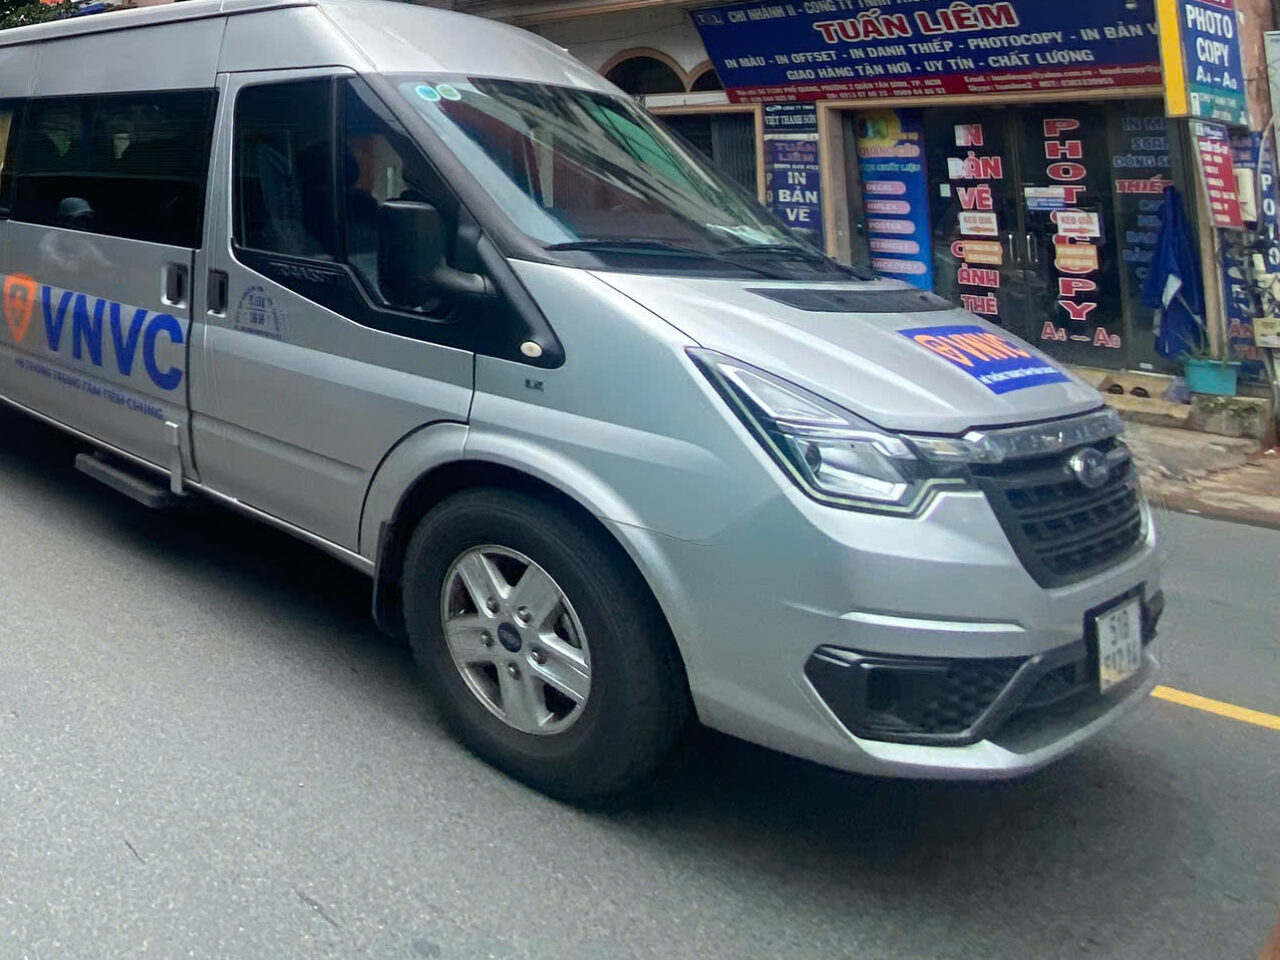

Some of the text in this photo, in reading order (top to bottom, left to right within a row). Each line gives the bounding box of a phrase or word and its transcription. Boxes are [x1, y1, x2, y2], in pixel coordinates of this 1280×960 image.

[728, 8, 747, 23] CHI
[749, 4, 785, 21] NHÁNH
[813, 1, 1020, 44] TUẤN LIÊM
[1185, 4, 1233, 39] PHOTO
[725, 21, 1158, 69] IN MÀU IN OFFSET IN DANH THIẾP PHOTOCOPY IN BẢN V
[1196, 37, 1229, 67] COPY
[786, 68, 816, 81] GIAO
[819, 65, 856, 80] HÀNG
[857, 62, 885, 79] TẬN
[924, 59, 943, 72] UY
[947, 55, 975, 71] TÍN
[988, 50, 1030, 68] CHẤT
[1036, 48, 1096, 66] LƯỢNG
[787, 171, 807, 186] IN
[947, 150, 1003, 180] BẢN
[778, 186, 818, 204] BẢN
[956, 184, 993, 210] VẼ
[785, 205, 811, 222] VẼ
[957, 262, 1000, 288] ẢNH
[960, 290, 999, 315] THẺ
[42, 284, 184, 392] VNVC
